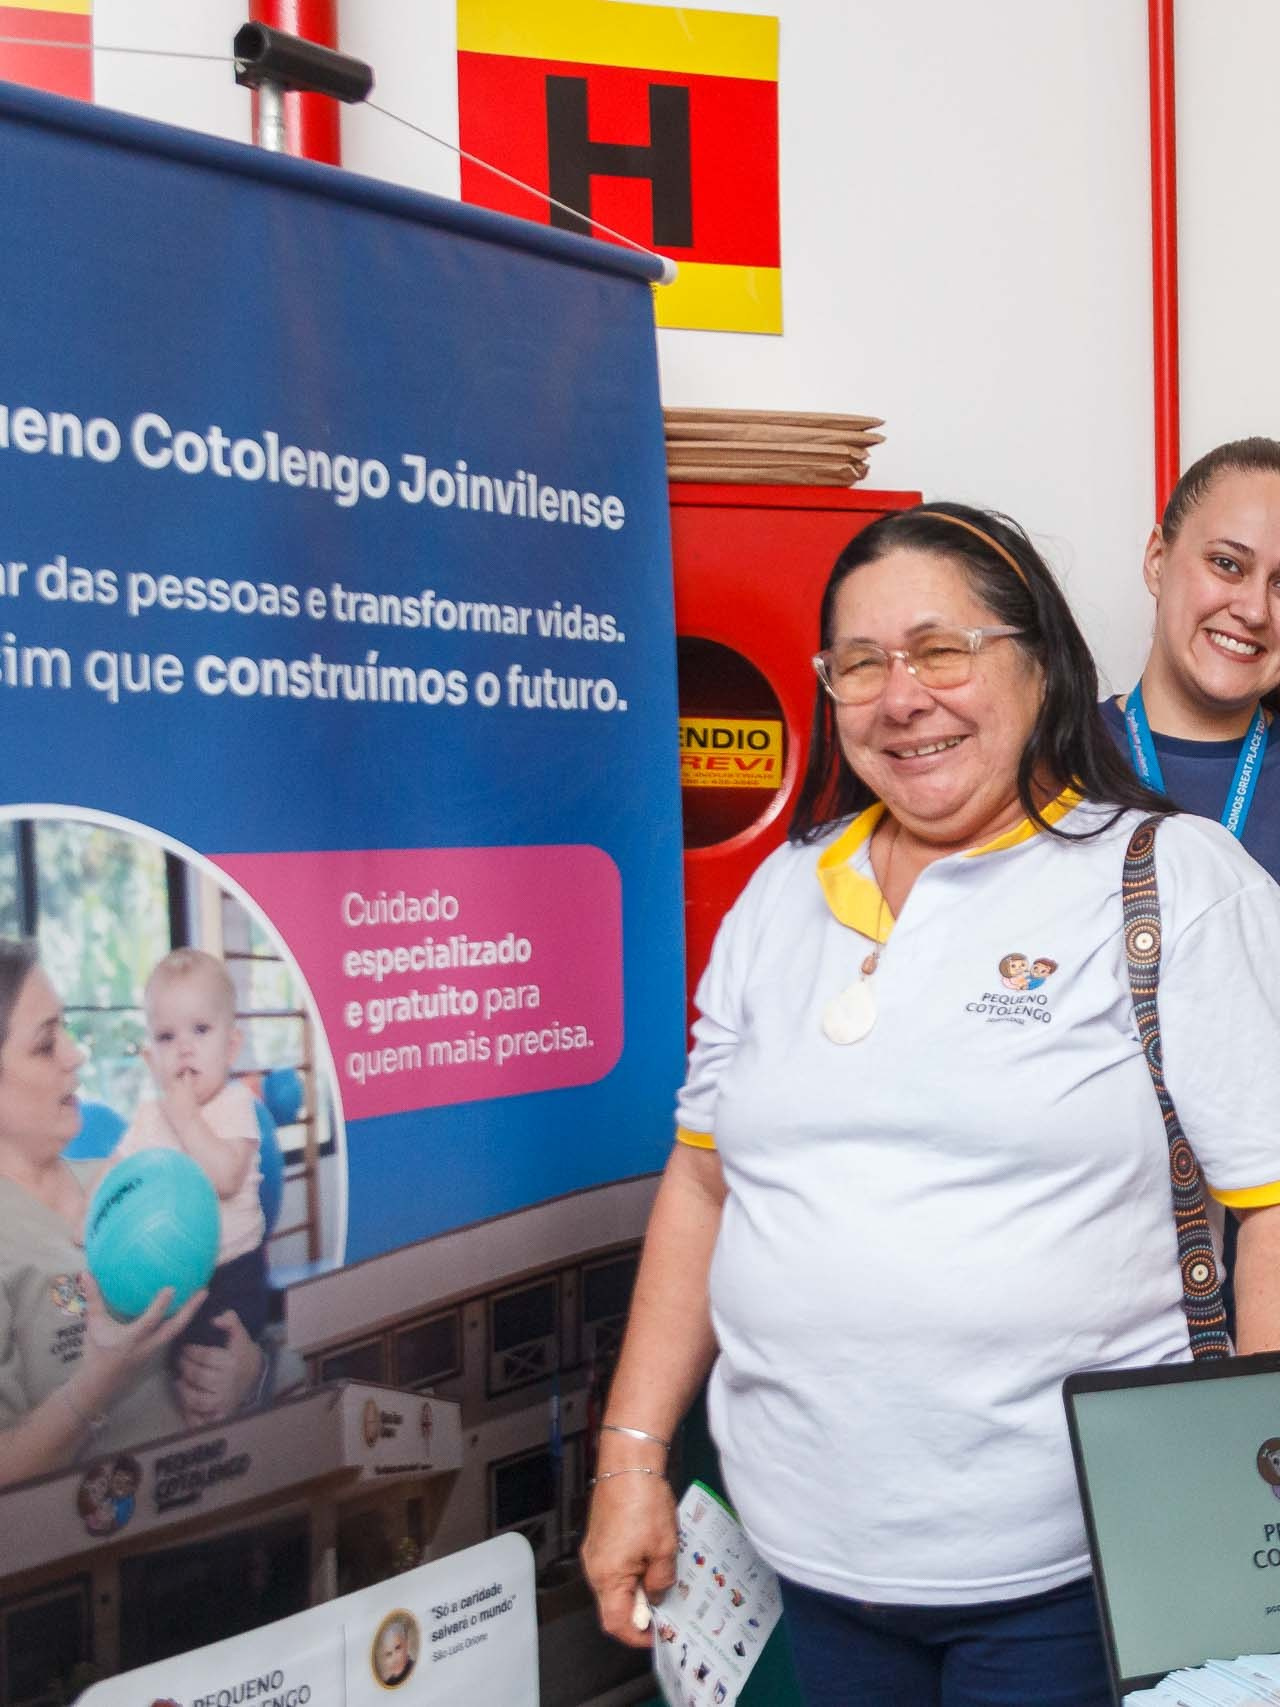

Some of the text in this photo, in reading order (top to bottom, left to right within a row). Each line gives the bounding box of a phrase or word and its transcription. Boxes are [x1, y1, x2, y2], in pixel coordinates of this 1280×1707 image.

[545, 74, 694, 249] H
[132, 412, 390, 506] Cotolengo
[400, 454, 626, 531] Joinvilense
[36, 555, 119, 605] das
[127, 572, 300, 618] pessoas
[306, 586, 327, 620] e
[330, 582, 533, 637] transformar
[536, 602, 626, 643] vidas.
[0, 631, 629, 712] im que construímos o futuro.
[679, 726, 771, 750] NDIO
[680, 756, 776, 772] REVI
[1237, 763, 1253, 795] GREAT
[1246, 733, 1262, 764] PLACE
[342, 889, 459, 926] Cuidado
[343, 932, 533, 982] especializado
[345, 984, 541, 1034] e gratuito para
[965, 1002, 1052, 1024] COTOLENGO
[982, 993, 1048, 1006] PEQUENO
[346, 1021, 595, 1084] quem mais precisa.
[460, 1582, 503, 1610] caridade
[193, 1669, 285, 1707] PEQUENO
